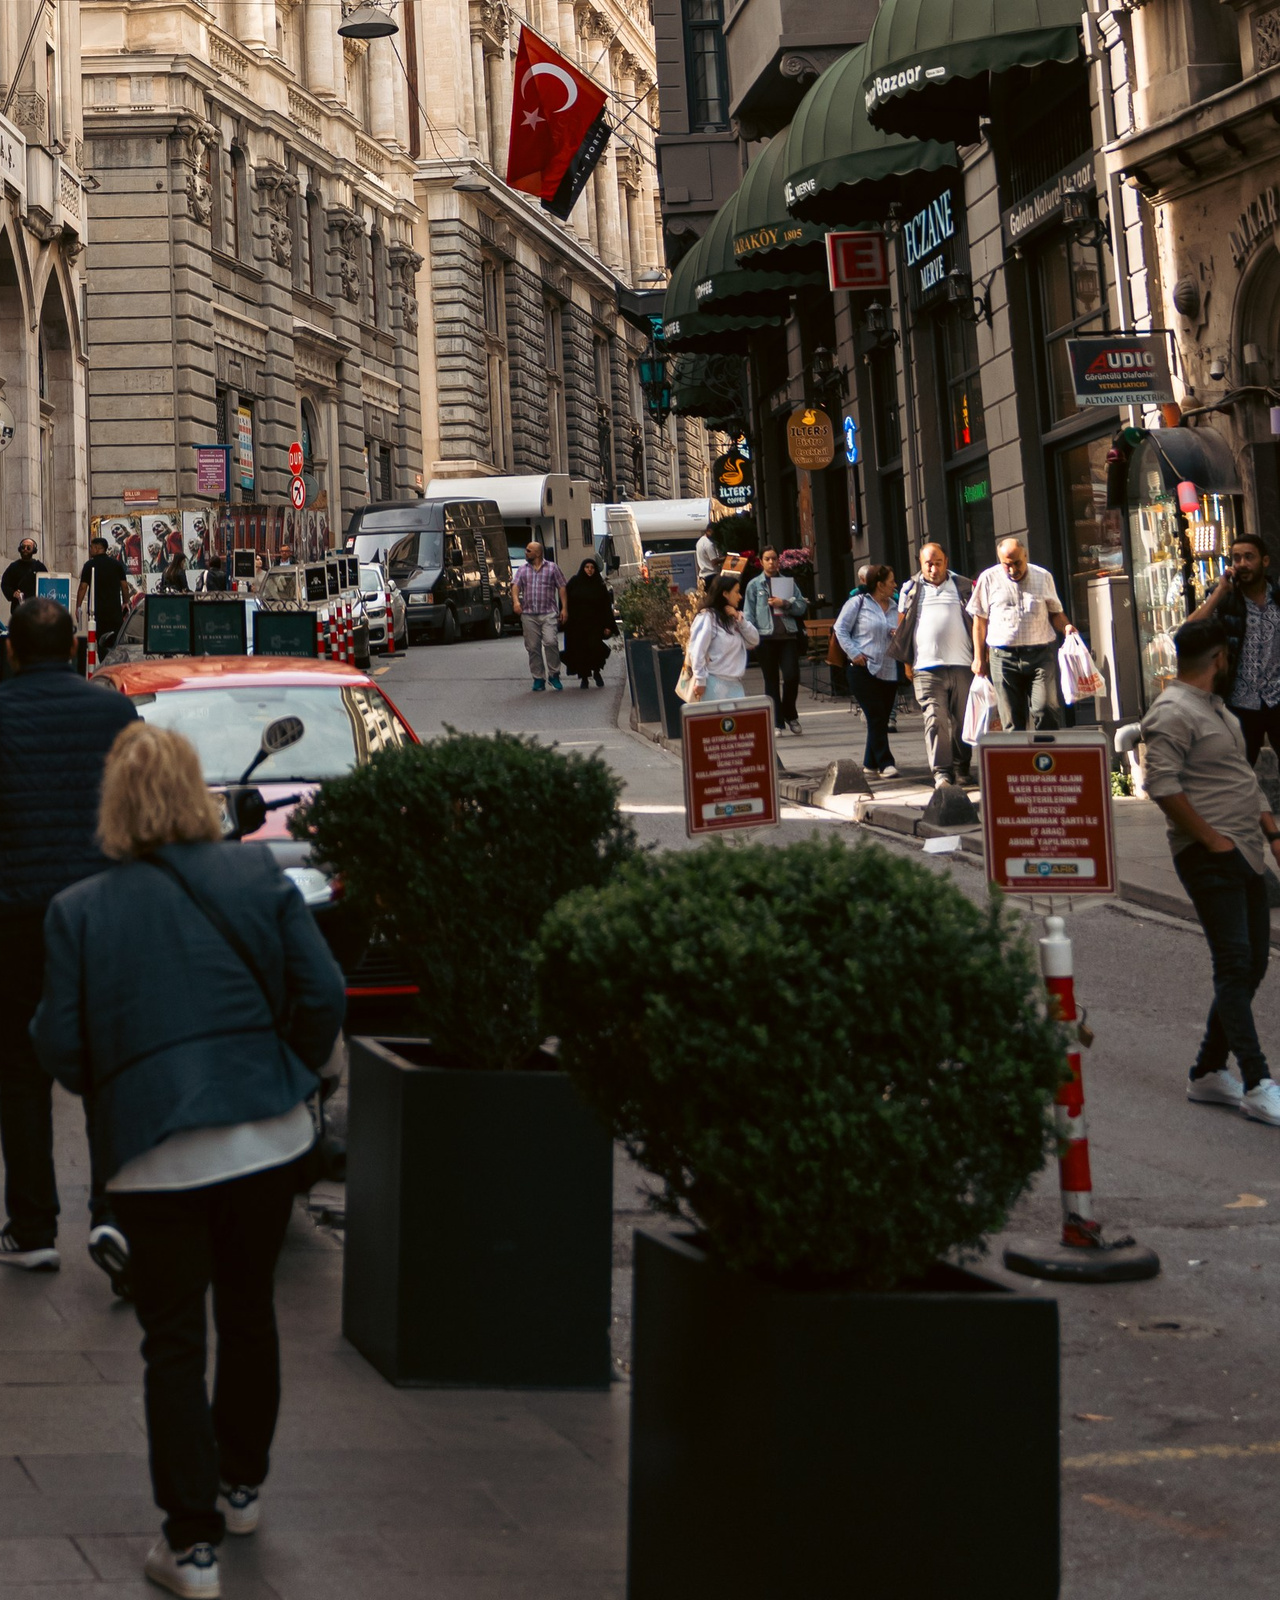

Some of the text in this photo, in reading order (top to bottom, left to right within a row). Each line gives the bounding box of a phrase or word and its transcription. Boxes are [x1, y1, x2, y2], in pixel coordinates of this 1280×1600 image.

[876, 65, 921, 97] Bazaar
[795, 178, 816, 197] MERVE
[1010, 206, 1034, 236] Galata
[1034, 177, 1062, 220] Natural
[783, 228, 803, 242] 1805
[904, 189, 954, 267] ECZANE
[920, 255, 945, 292] MERVE
[1085, 394, 1124, 405] ALTUNAY
[289, 452, 302, 466] DUR
